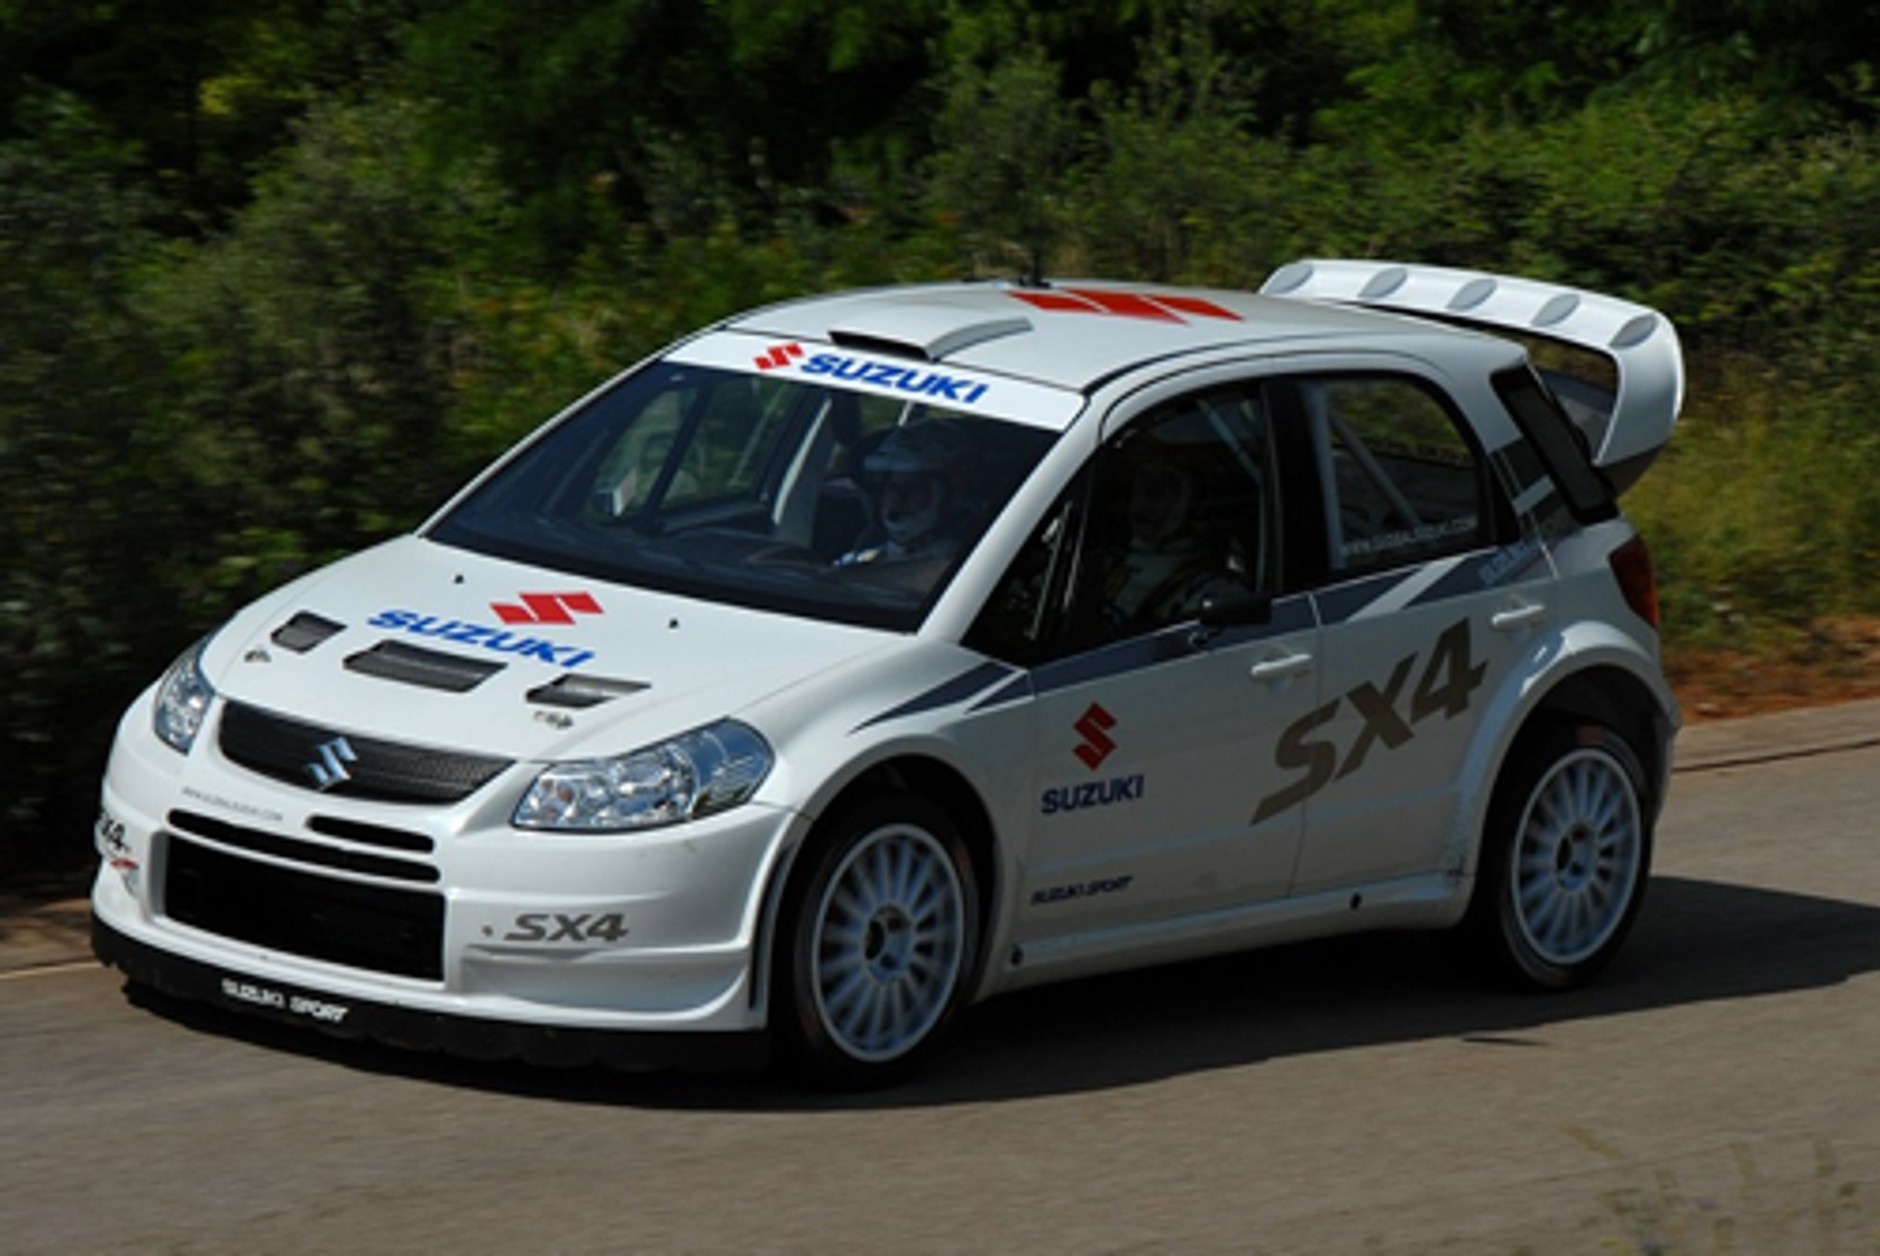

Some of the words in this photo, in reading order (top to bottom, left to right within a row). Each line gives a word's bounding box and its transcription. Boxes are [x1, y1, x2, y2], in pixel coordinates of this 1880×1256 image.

[801, 353, 990, 404] SUZUKI
[367, 609, 595, 669] SUZUKI
[1250, 616, 1489, 827] SX4
[1041, 773, 1145, 815] SUZUKI
[503, 912, 630, 942] SX4
[221, 977, 286, 1010] SUZUKI
[290, 995, 349, 1024] SPORT
